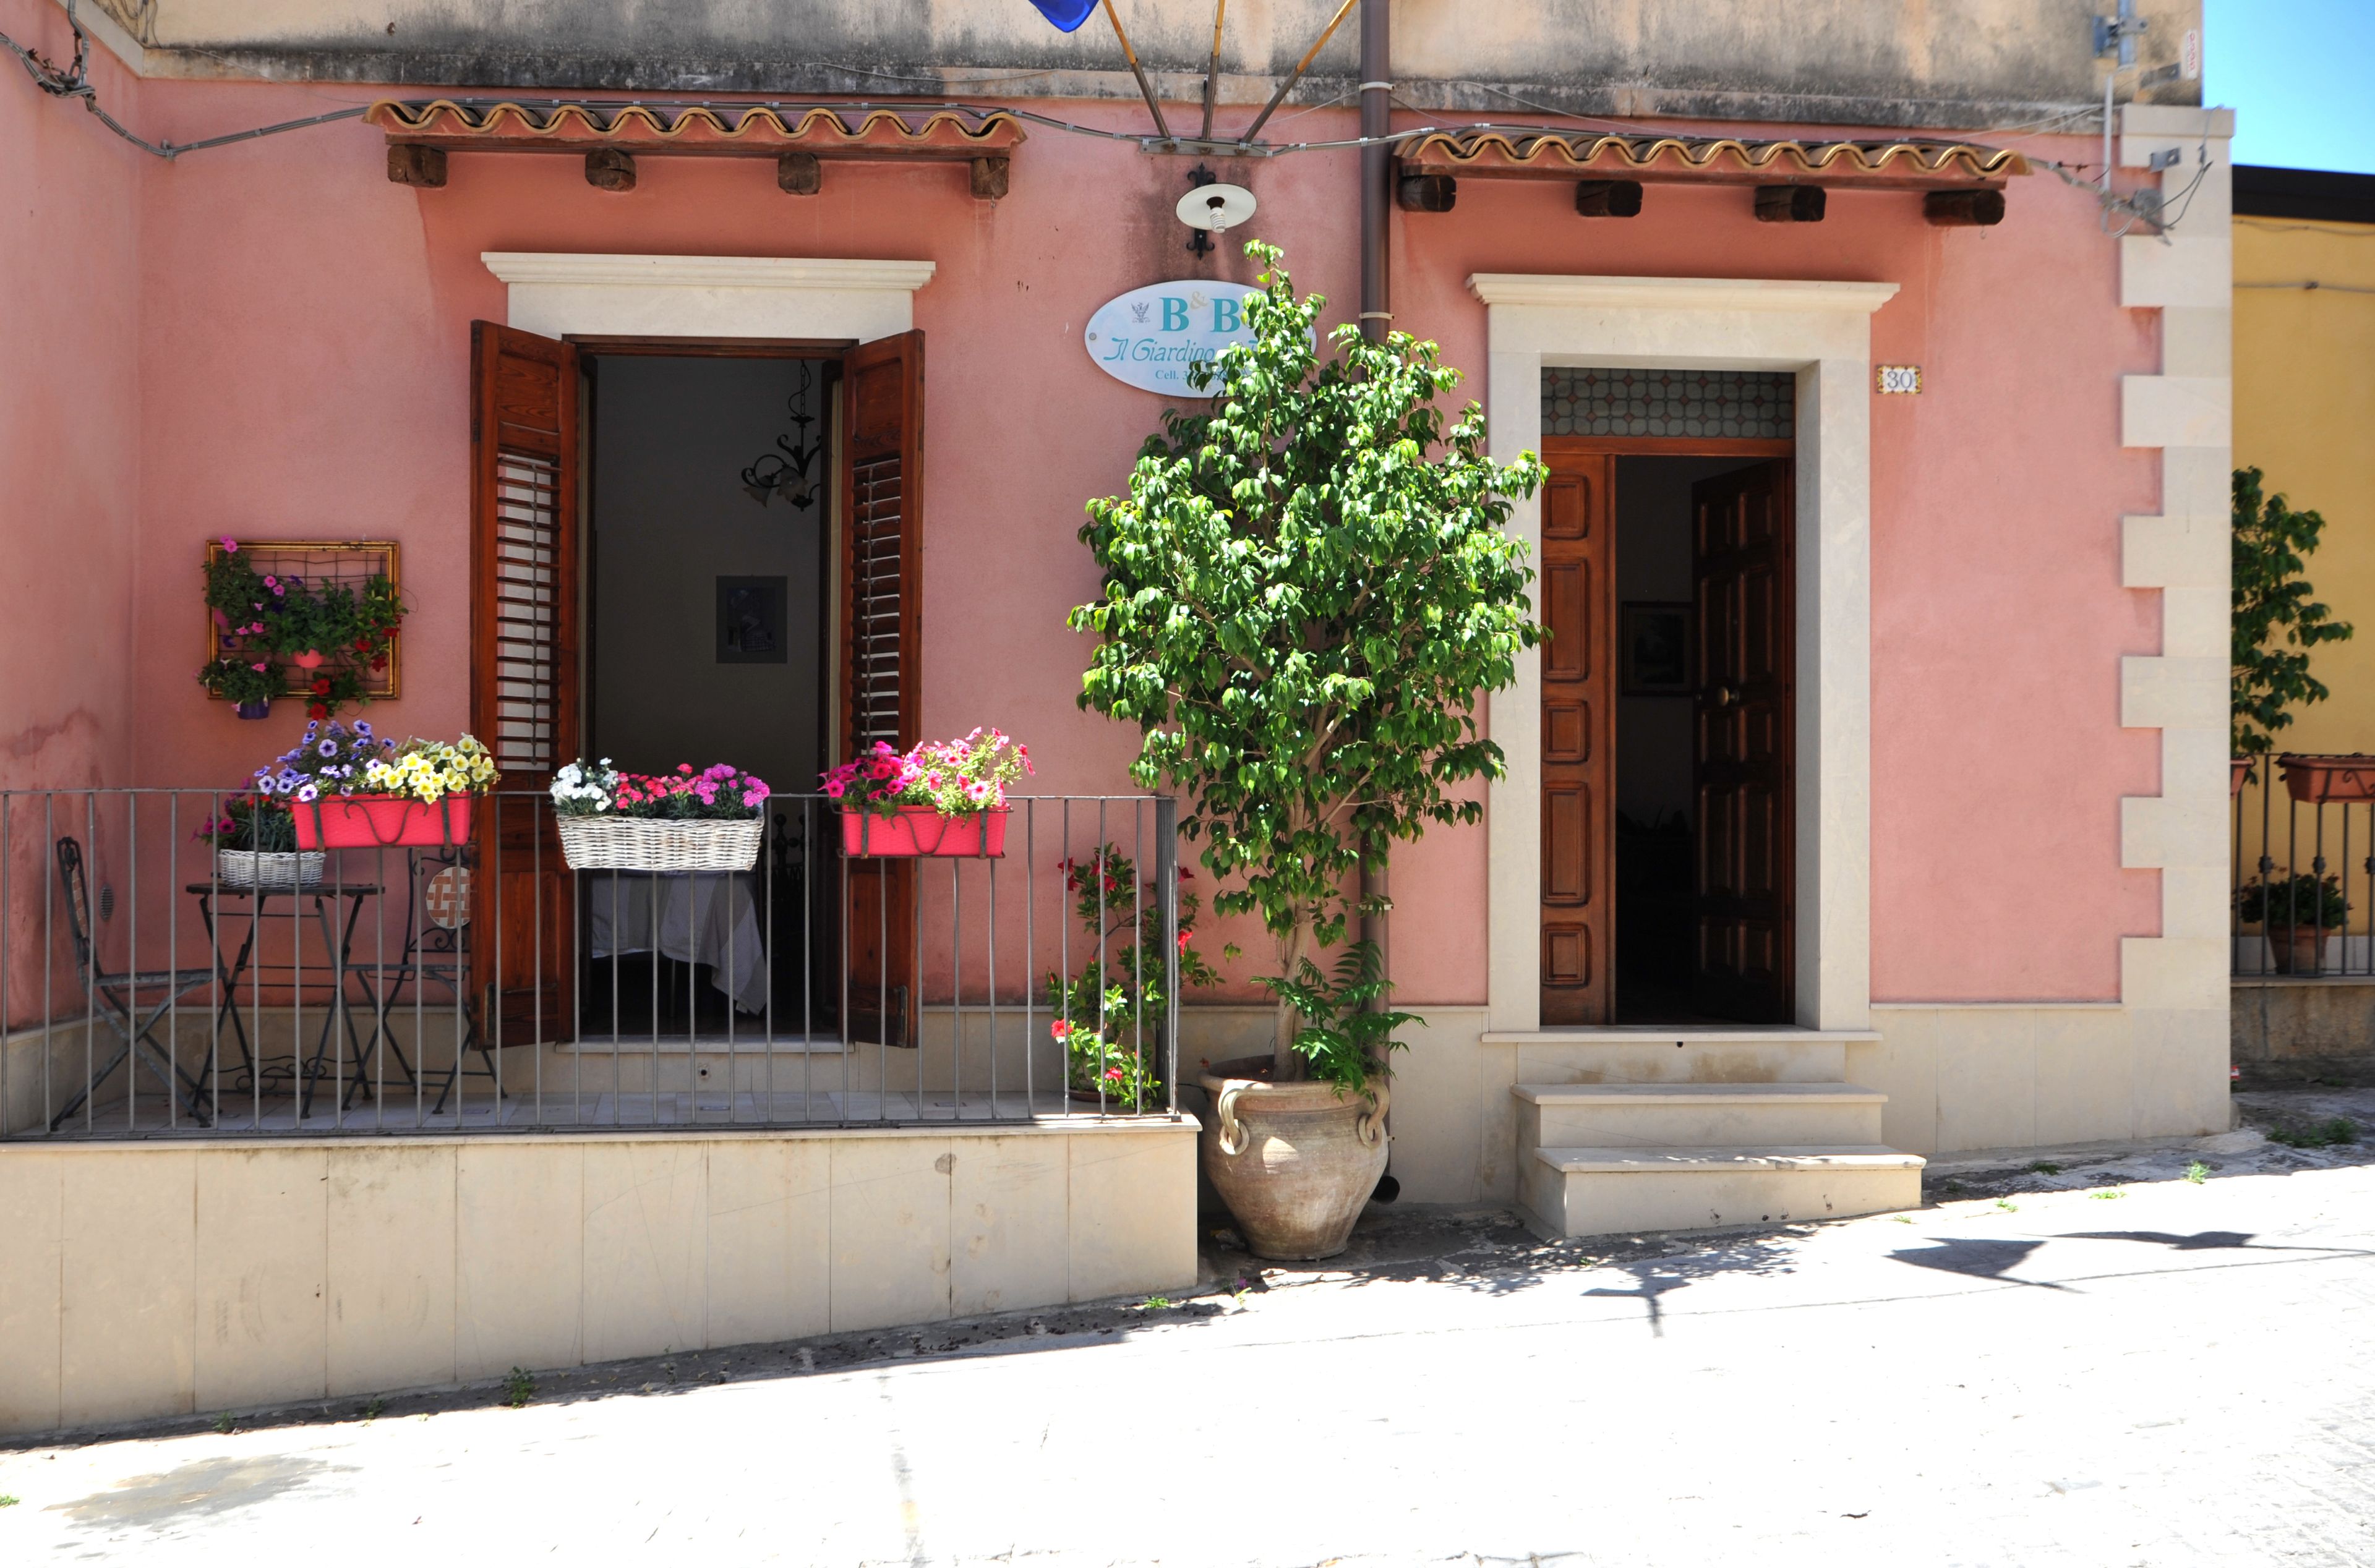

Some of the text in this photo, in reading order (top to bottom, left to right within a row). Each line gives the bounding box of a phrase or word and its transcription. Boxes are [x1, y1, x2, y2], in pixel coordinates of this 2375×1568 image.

[1132, 338, 1215, 362] Giardino
[1155, 370, 1179, 380] Cell.
[1887, 371, 1913, 388] 30
